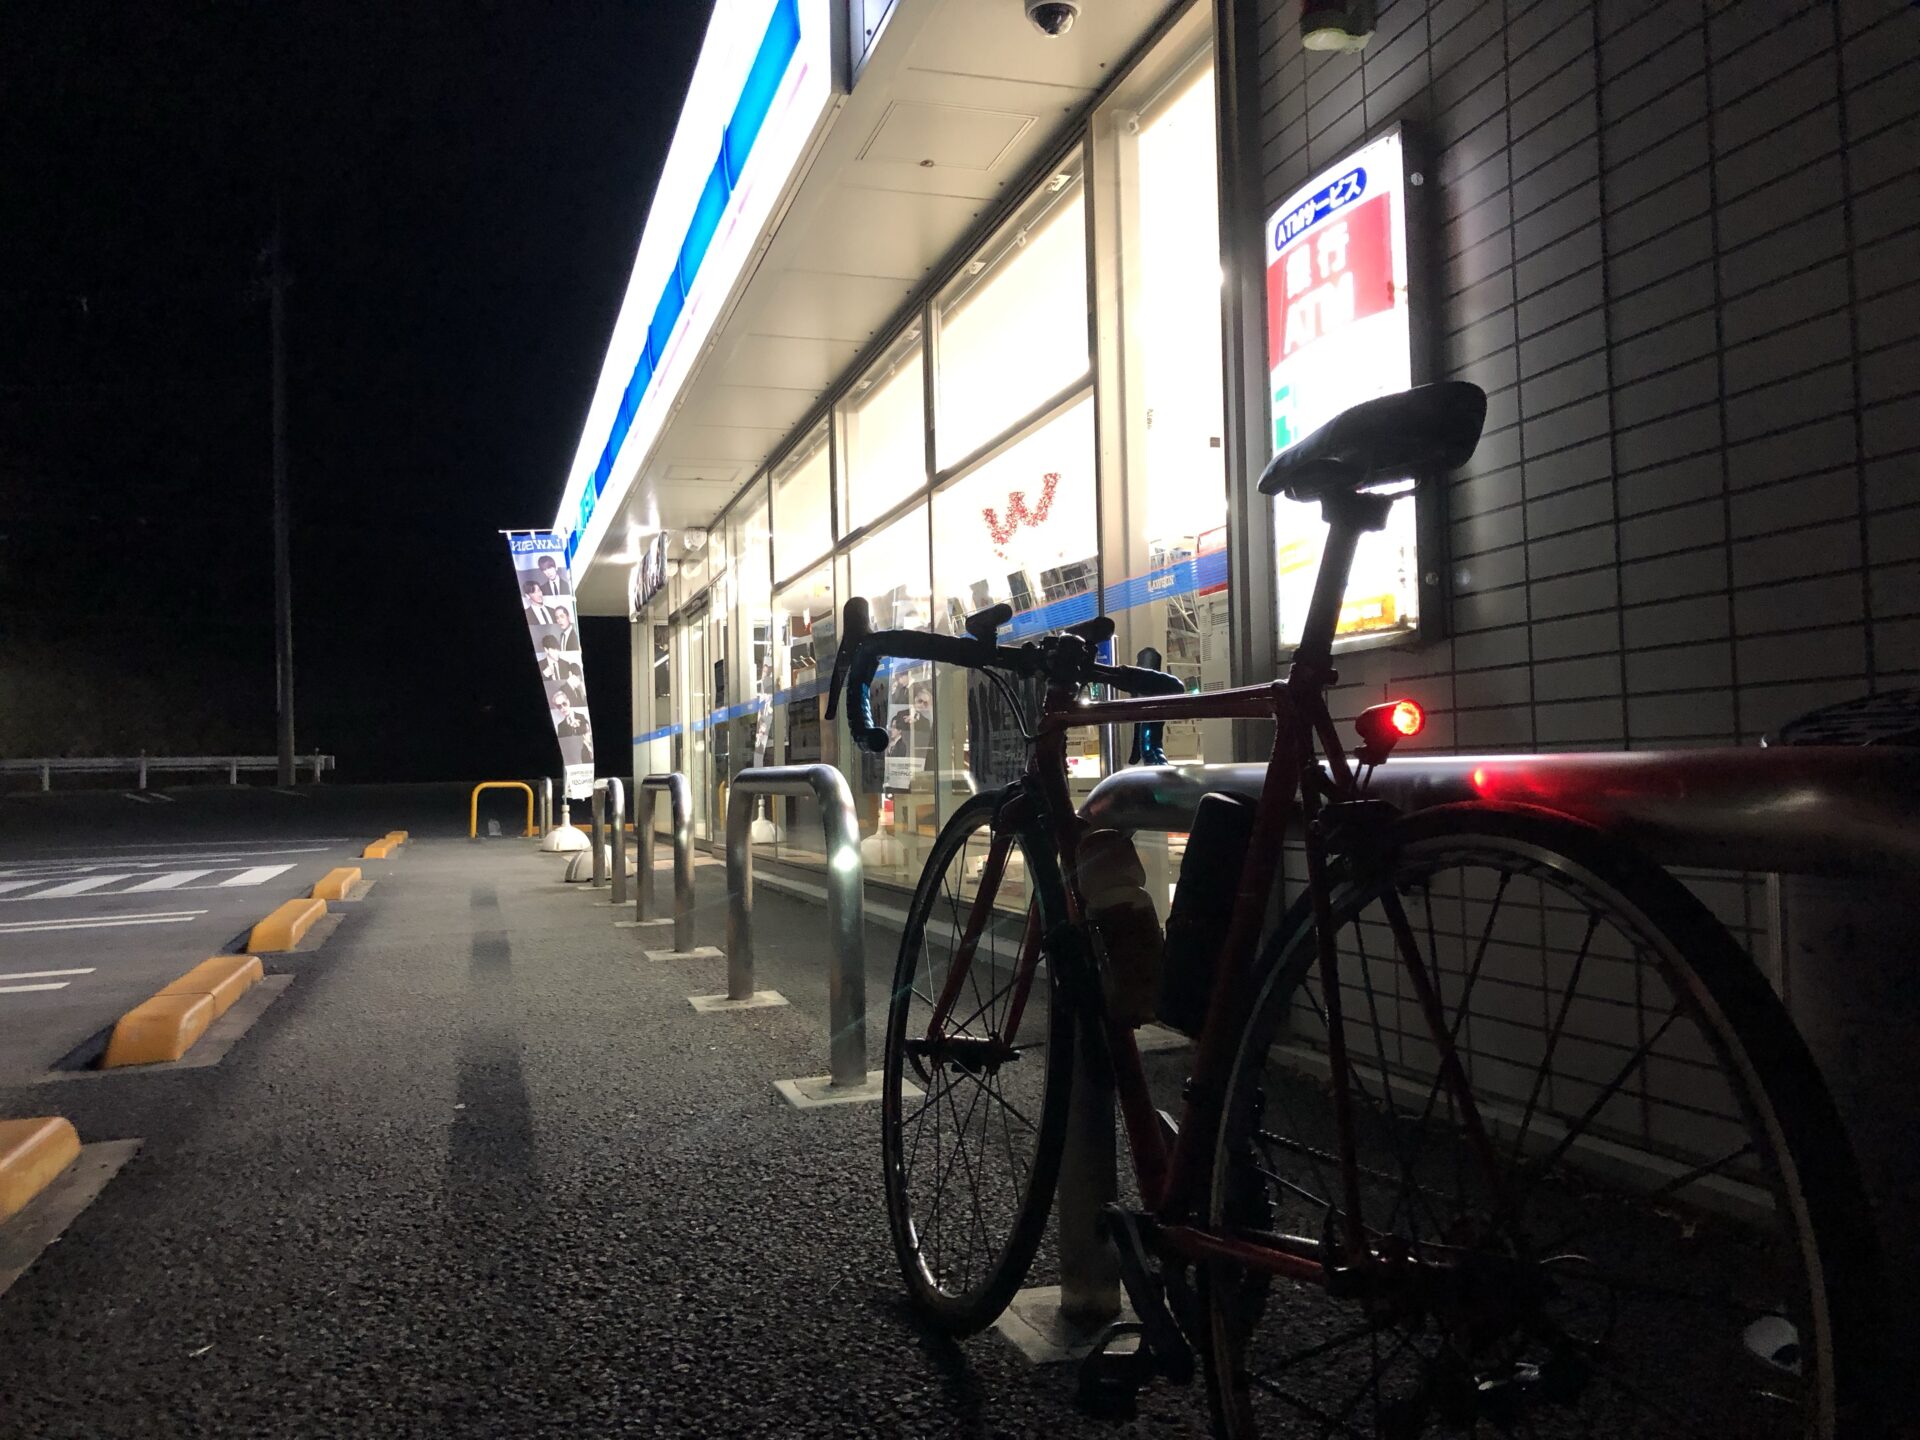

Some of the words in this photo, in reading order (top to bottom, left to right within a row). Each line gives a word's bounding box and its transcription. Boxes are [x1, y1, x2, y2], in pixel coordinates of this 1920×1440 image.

[1277, 171, 1362, 247] ATMサービス
[1283, 271, 1354, 354] ATM
